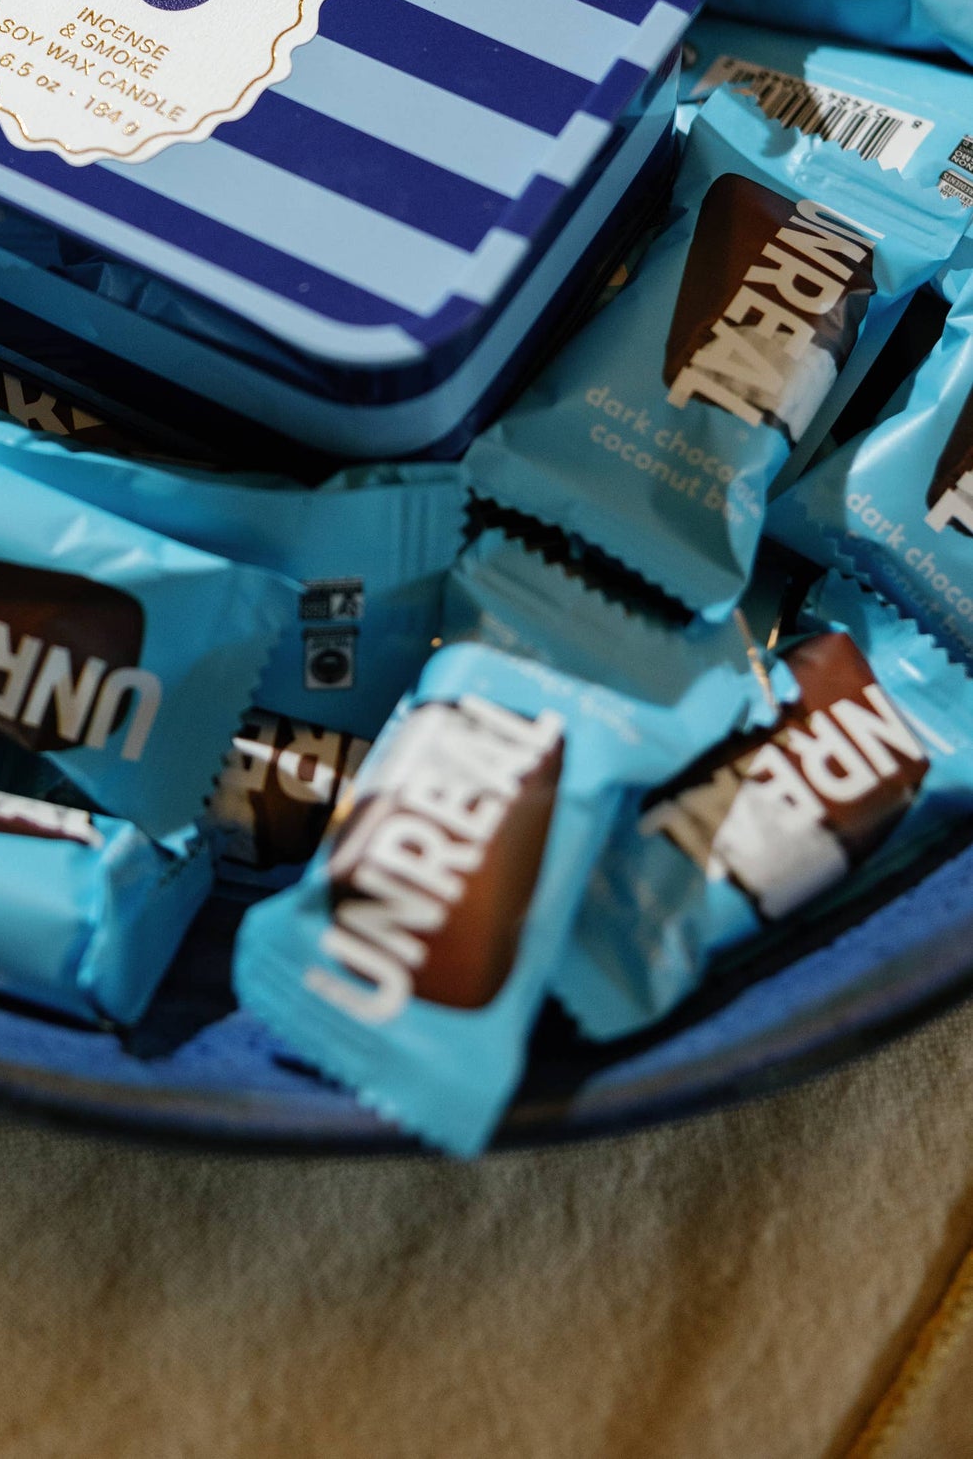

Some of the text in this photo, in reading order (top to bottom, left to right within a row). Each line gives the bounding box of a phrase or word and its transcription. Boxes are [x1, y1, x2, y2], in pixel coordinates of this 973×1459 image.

[59, 22, 159, 80] & SMOKE
[77, 6, 171, 62] INCENSE
[35, 74, 62, 94] oz
[83, 94, 124, 125] 184
[45, 41, 96, 76] WAX
[98, 70, 188, 122] CANDLE
[667, 199, 886, 428] UNREAL
[585, 386, 652, 435] dark
[590, 423, 702, 500] coconut
[845, 493, 906, 550] dark
[904, 546, 973, 623] choco
[638, 682, 955, 881] NREAL
[305, 694, 568, 1025] UNREAL
